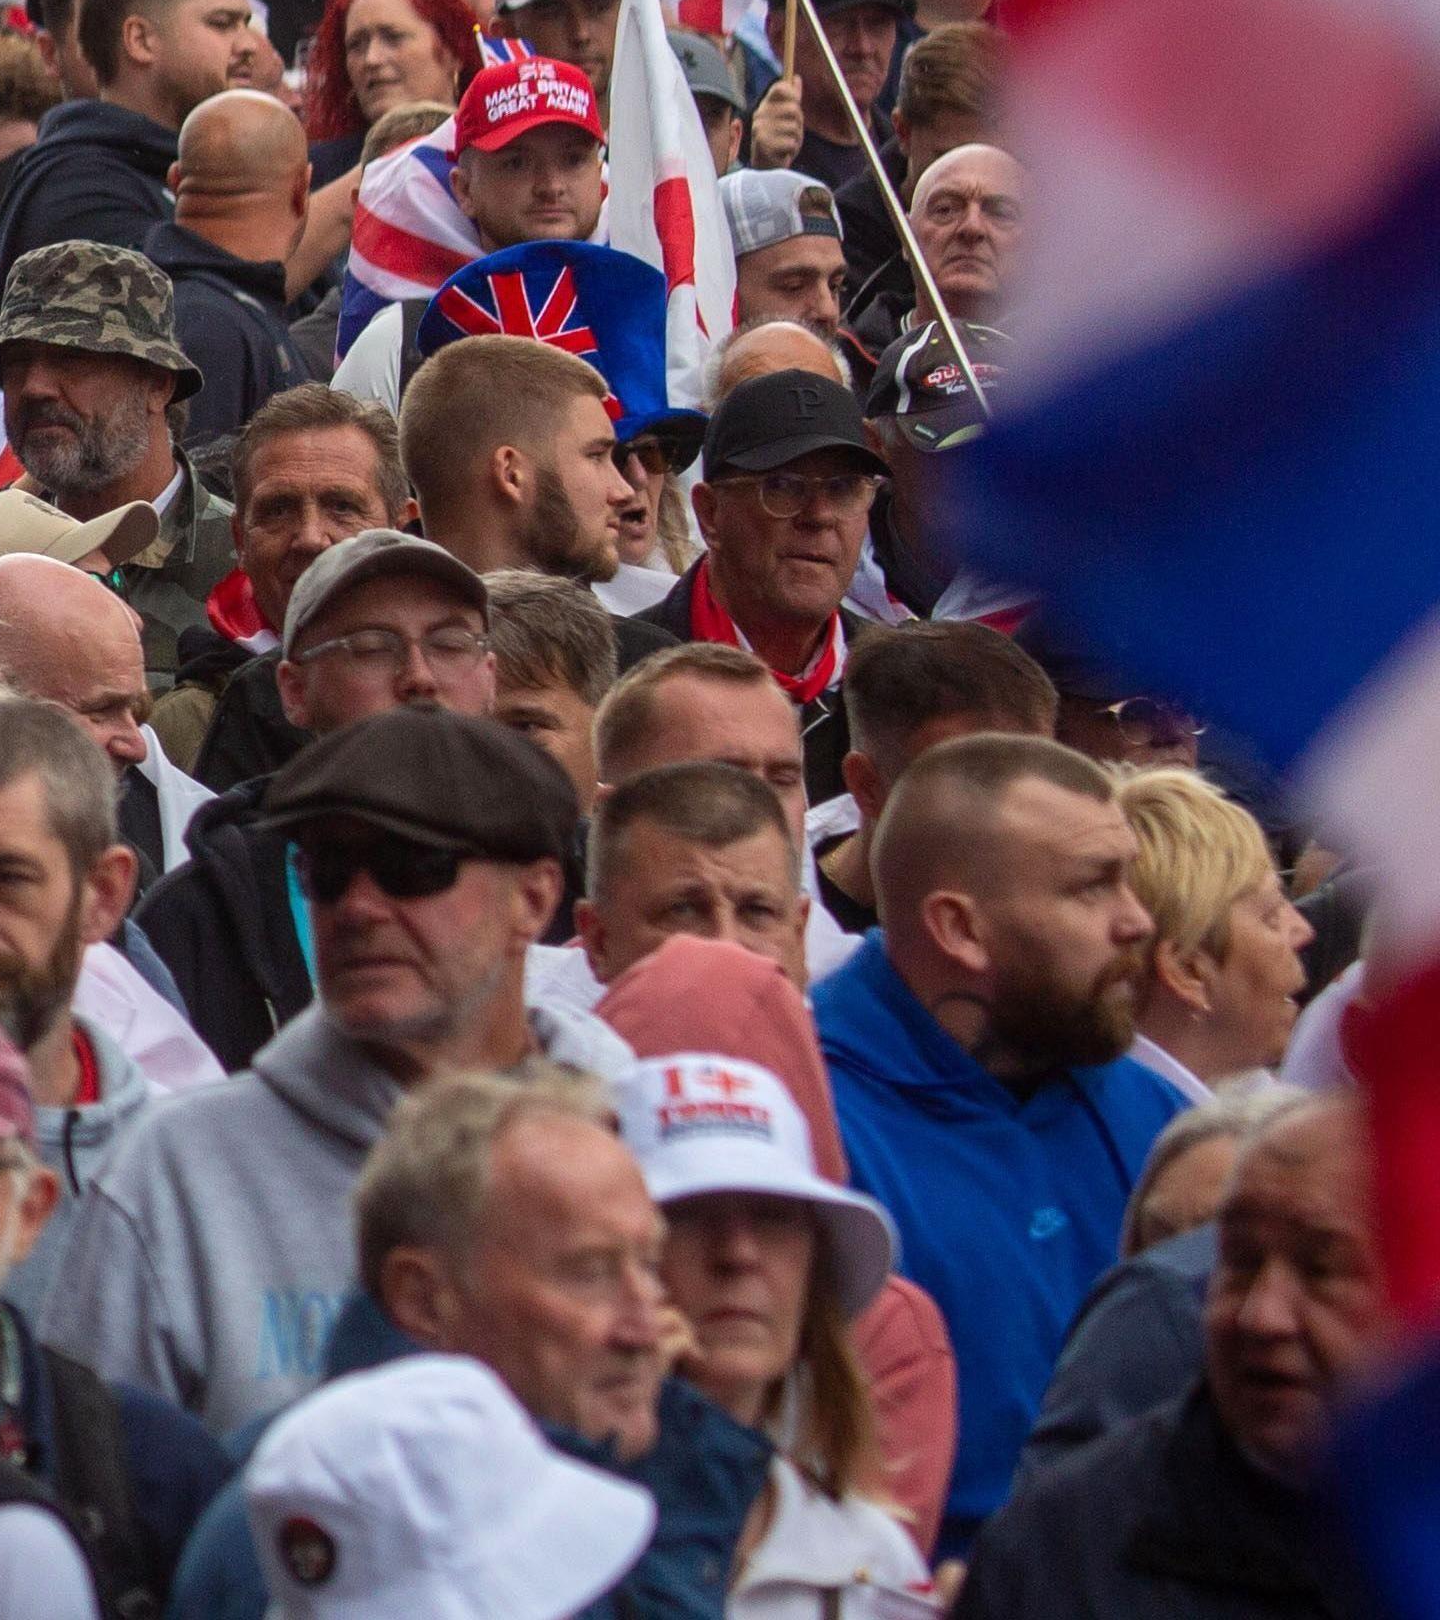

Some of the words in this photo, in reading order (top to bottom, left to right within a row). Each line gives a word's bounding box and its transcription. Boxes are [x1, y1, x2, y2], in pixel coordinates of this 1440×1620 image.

[484, 80, 530, 110] MAKE
[536, 78, 590, 106] BRITAIN
[487, 93, 538, 123] GREAT
[546, 92, 588, 119] AGAIN
